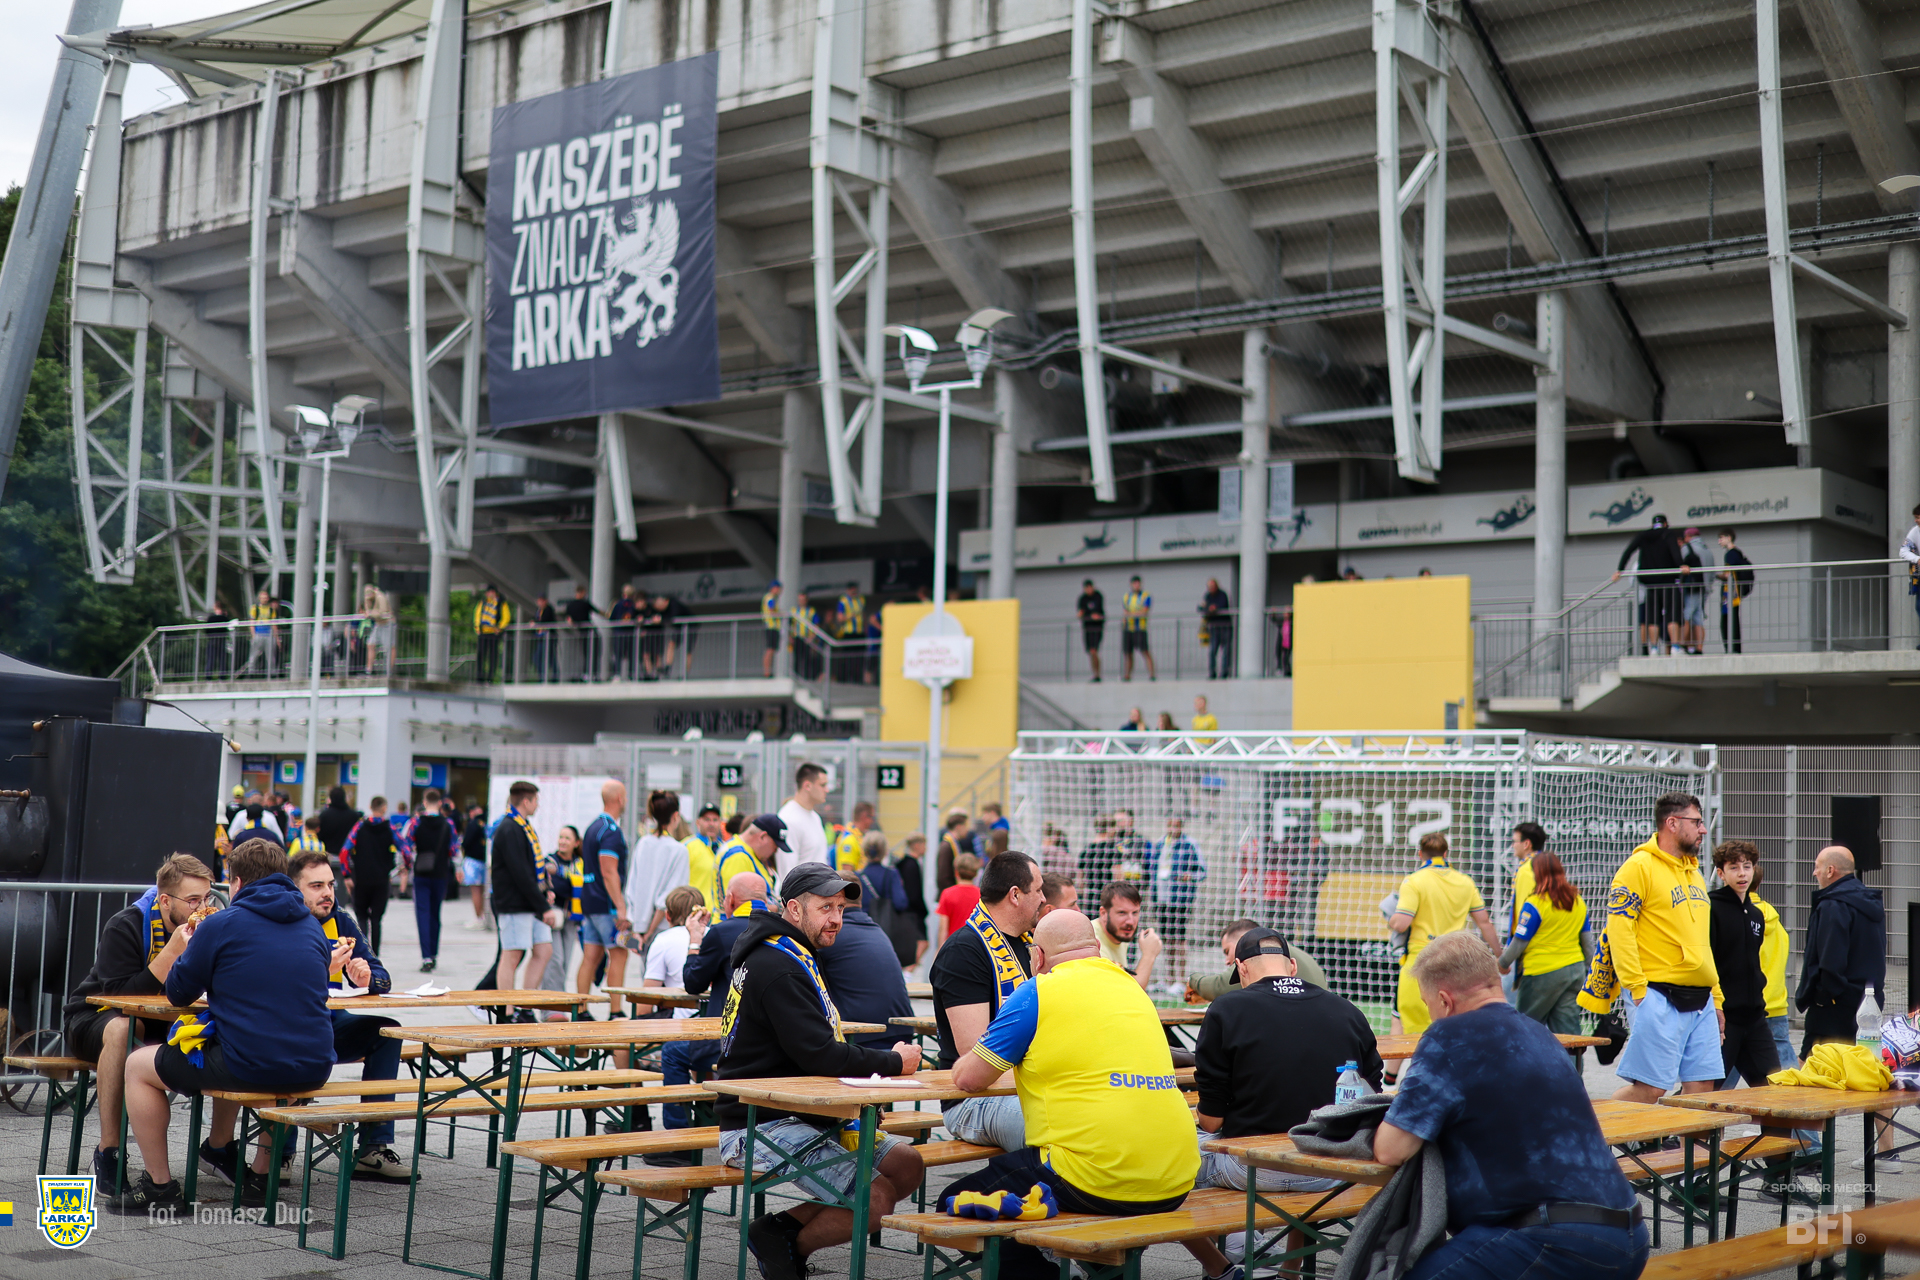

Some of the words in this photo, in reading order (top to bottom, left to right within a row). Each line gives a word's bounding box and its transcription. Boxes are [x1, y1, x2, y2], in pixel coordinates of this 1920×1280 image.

[512, 103, 684, 222] KASZËBË
[510, 207, 610, 296] ZNACZ
[512, 285, 612, 371] ARKA
[881, 768, 900, 786] 12
[1273, 798, 1453, 846] FC12
[1273, 978, 1302, 987] MZKS
[1278, 986, 1300, 994] 1929
